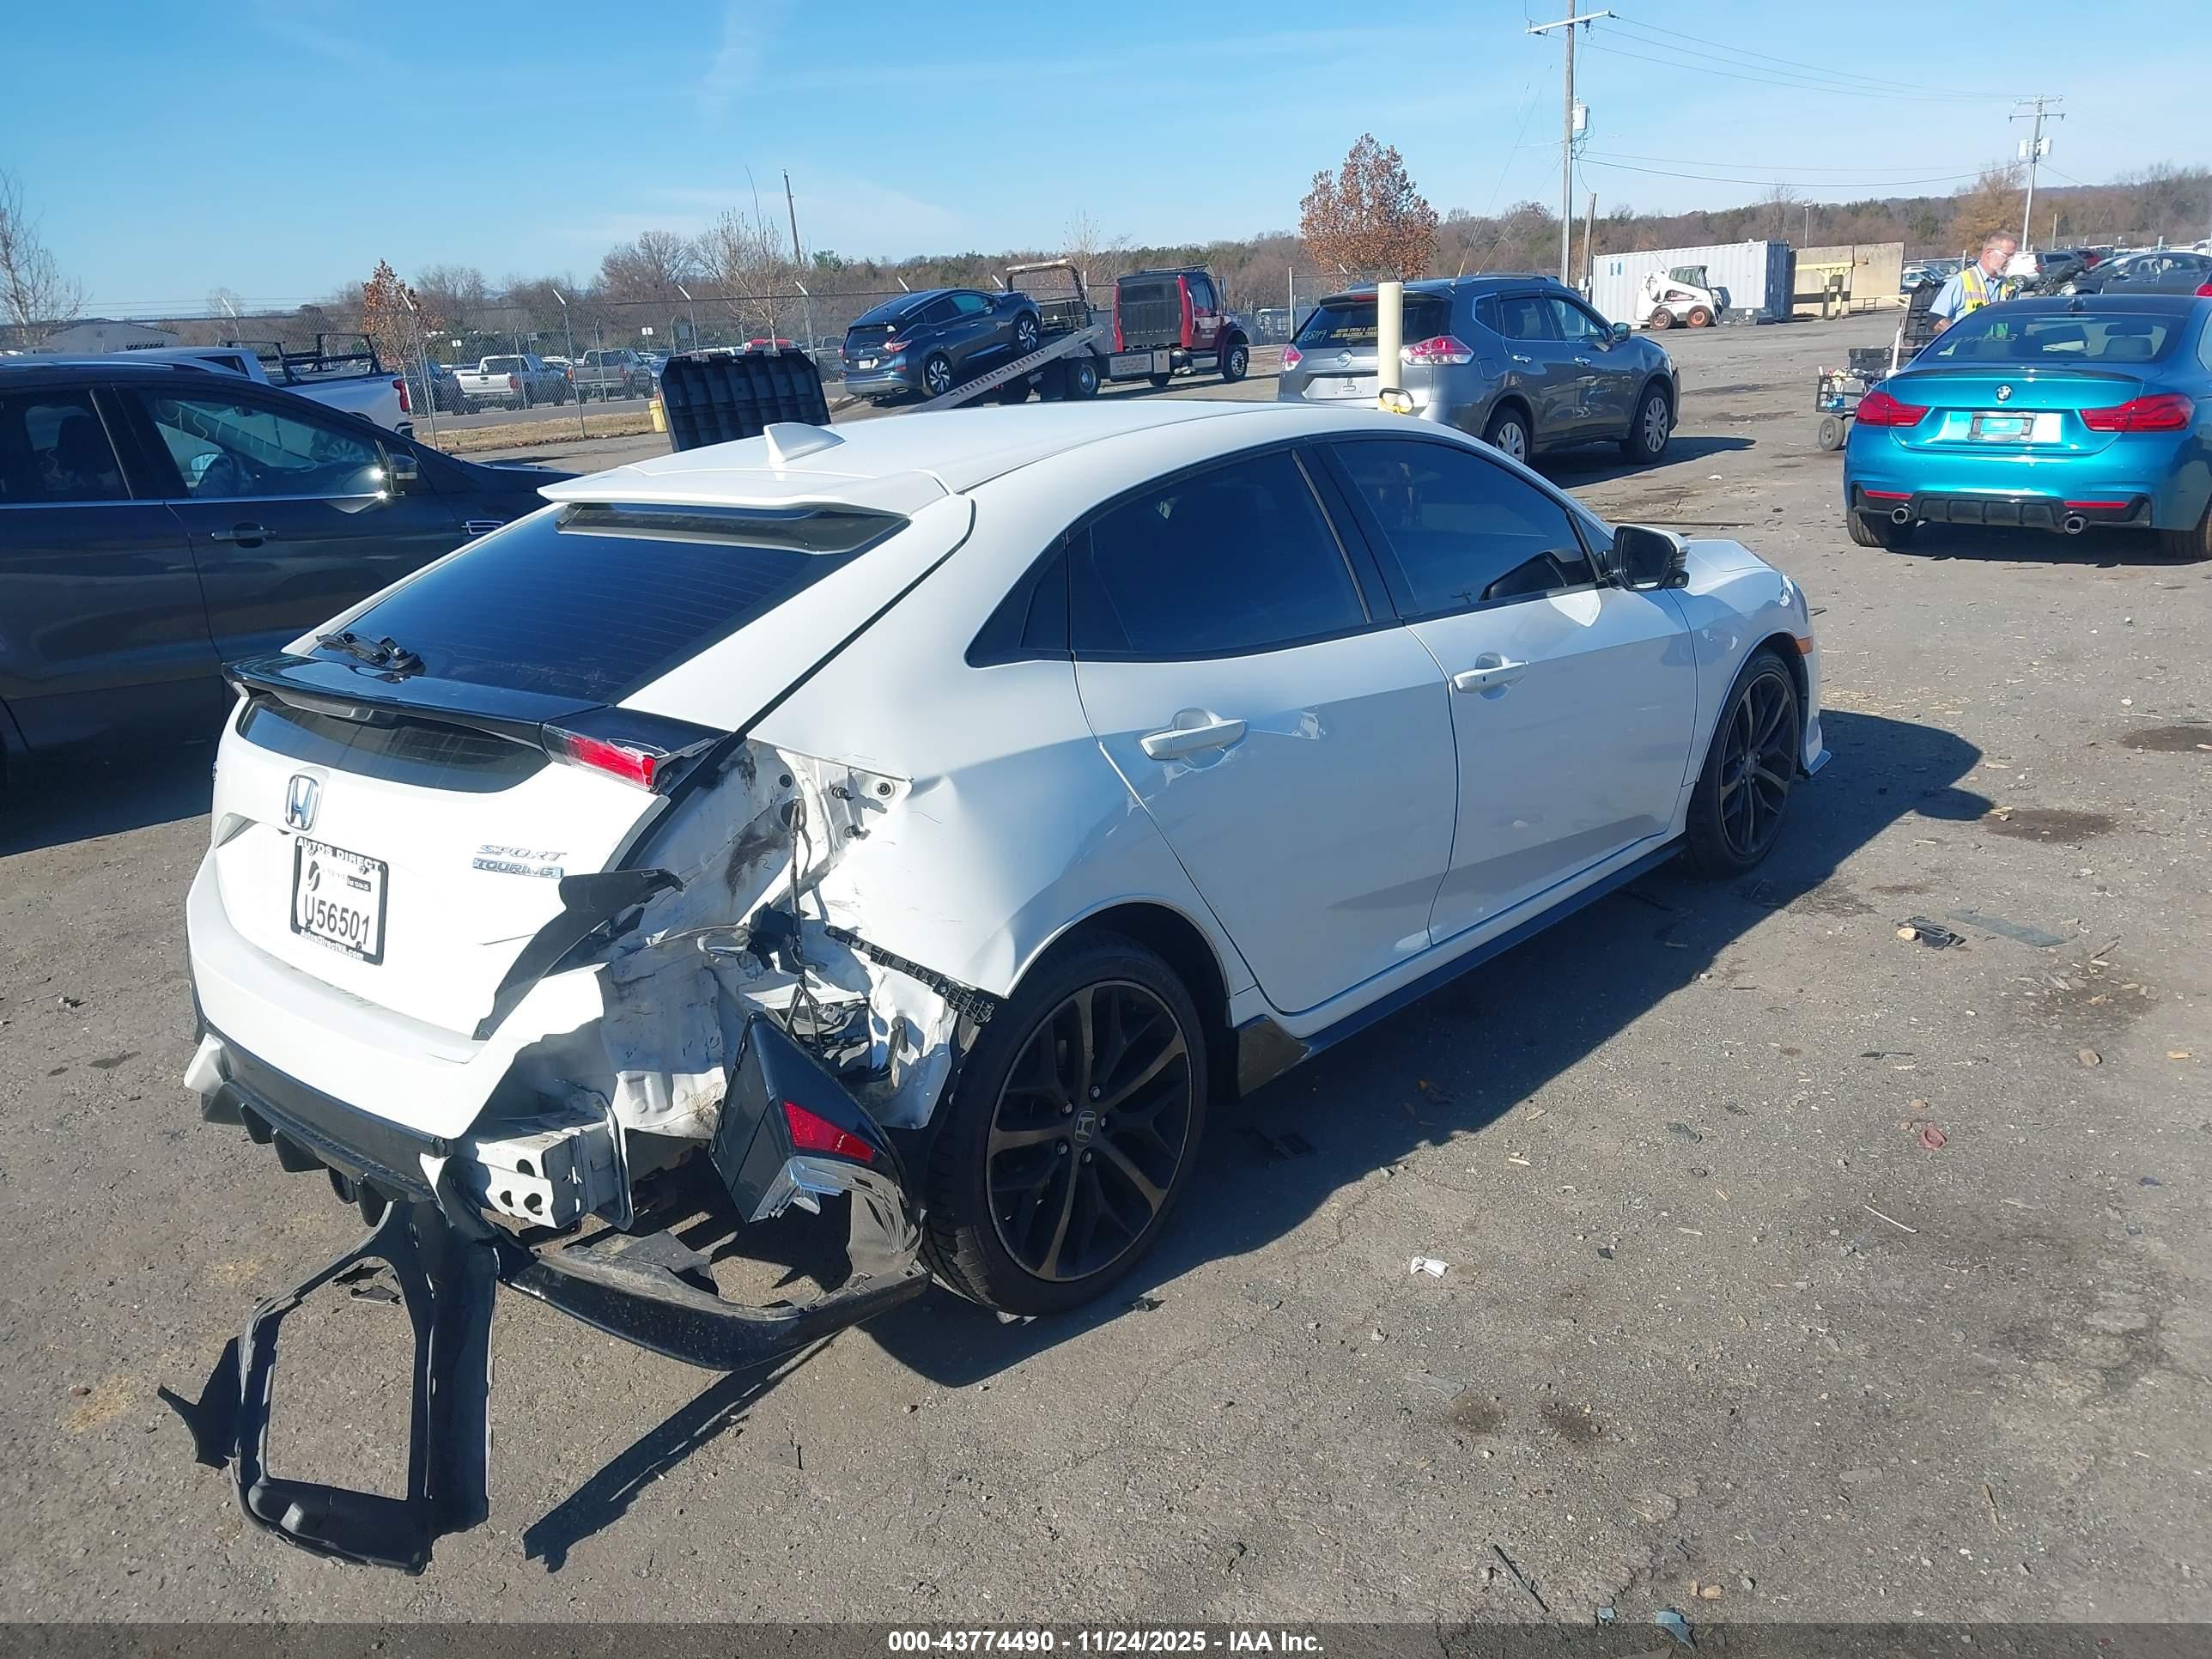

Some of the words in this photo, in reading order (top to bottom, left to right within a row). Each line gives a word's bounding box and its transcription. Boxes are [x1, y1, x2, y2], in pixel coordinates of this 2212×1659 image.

[297, 837, 333, 857] AUTOS
[336, 849, 380, 872] DIRECT
[477, 844, 568, 861] SPORT
[475, 859, 561, 878] TOURING
[305, 894, 370, 945] U56501
